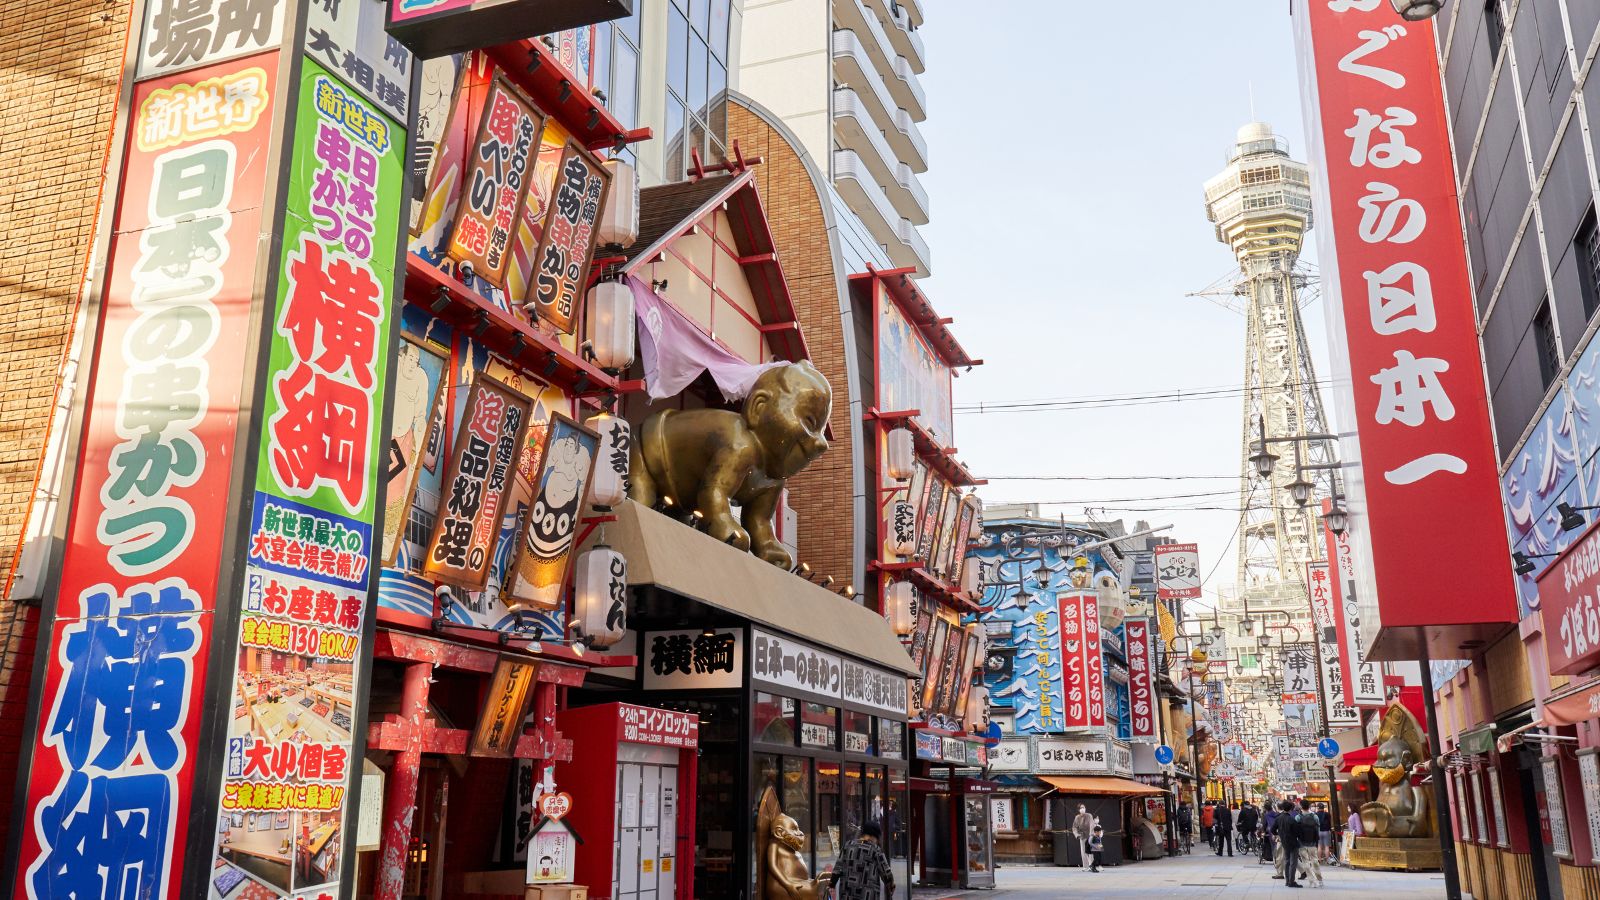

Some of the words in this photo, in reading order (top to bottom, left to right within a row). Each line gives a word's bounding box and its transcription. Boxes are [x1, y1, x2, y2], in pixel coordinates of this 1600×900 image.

[307, 27, 406, 116] 大相撲
[141, 73, 265, 146] 新世界
[317, 80, 391, 152] 新世界
[313, 122, 352, 243] 串かつ
[346, 144, 377, 260] 日本一の
[537, 157, 588, 304] 名物串かつ
[1327, 0, 1468, 486] ぐなら日本一
[104, 146, 232, 568] 日本一の串かつ
[273, 240, 381, 508] 横綱
[432, 388, 504, 569] 逸品料理
[468, 405, 522, 570] 料理長自慢の
[264, 505, 361, 552] 新世界最大の
[252, 532, 367, 580] 大宴会場完備!!
[1159, 565, 1198, 580] エビス
[249, 575, 261, 609] 2階
[263, 580, 362, 629] お座敷席
[1312, 570, 1329, 607] 串かつ
[1065, 604, 1078, 634] 名物
[1086, 603, 1097, 633] 名物
[650, 633, 736, 675] 横綱
[755, 636, 840, 693] 日本一の串かつ
[1288, 653, 1309, 694] 串か
[845, 664, 864, 701] 横綱
[1067, 656, 1082, 720] てっちり
[1089, 656, 1101, 719] てっちり
[1129, 641, 1149, 733] 珍味てっちり
[32, 586, 199, 900] 横綱
[625, 708, 638, 724] 24h
[639, 709, 698, 736] コインロッカー
[230, 740, 242, 776] 2階
[243, 740, 346, 779] 大小個室
[1042, 749, 1103, 761] づぼらや本店
[222, 783, 345, 810] ご家族連れに最適!!
